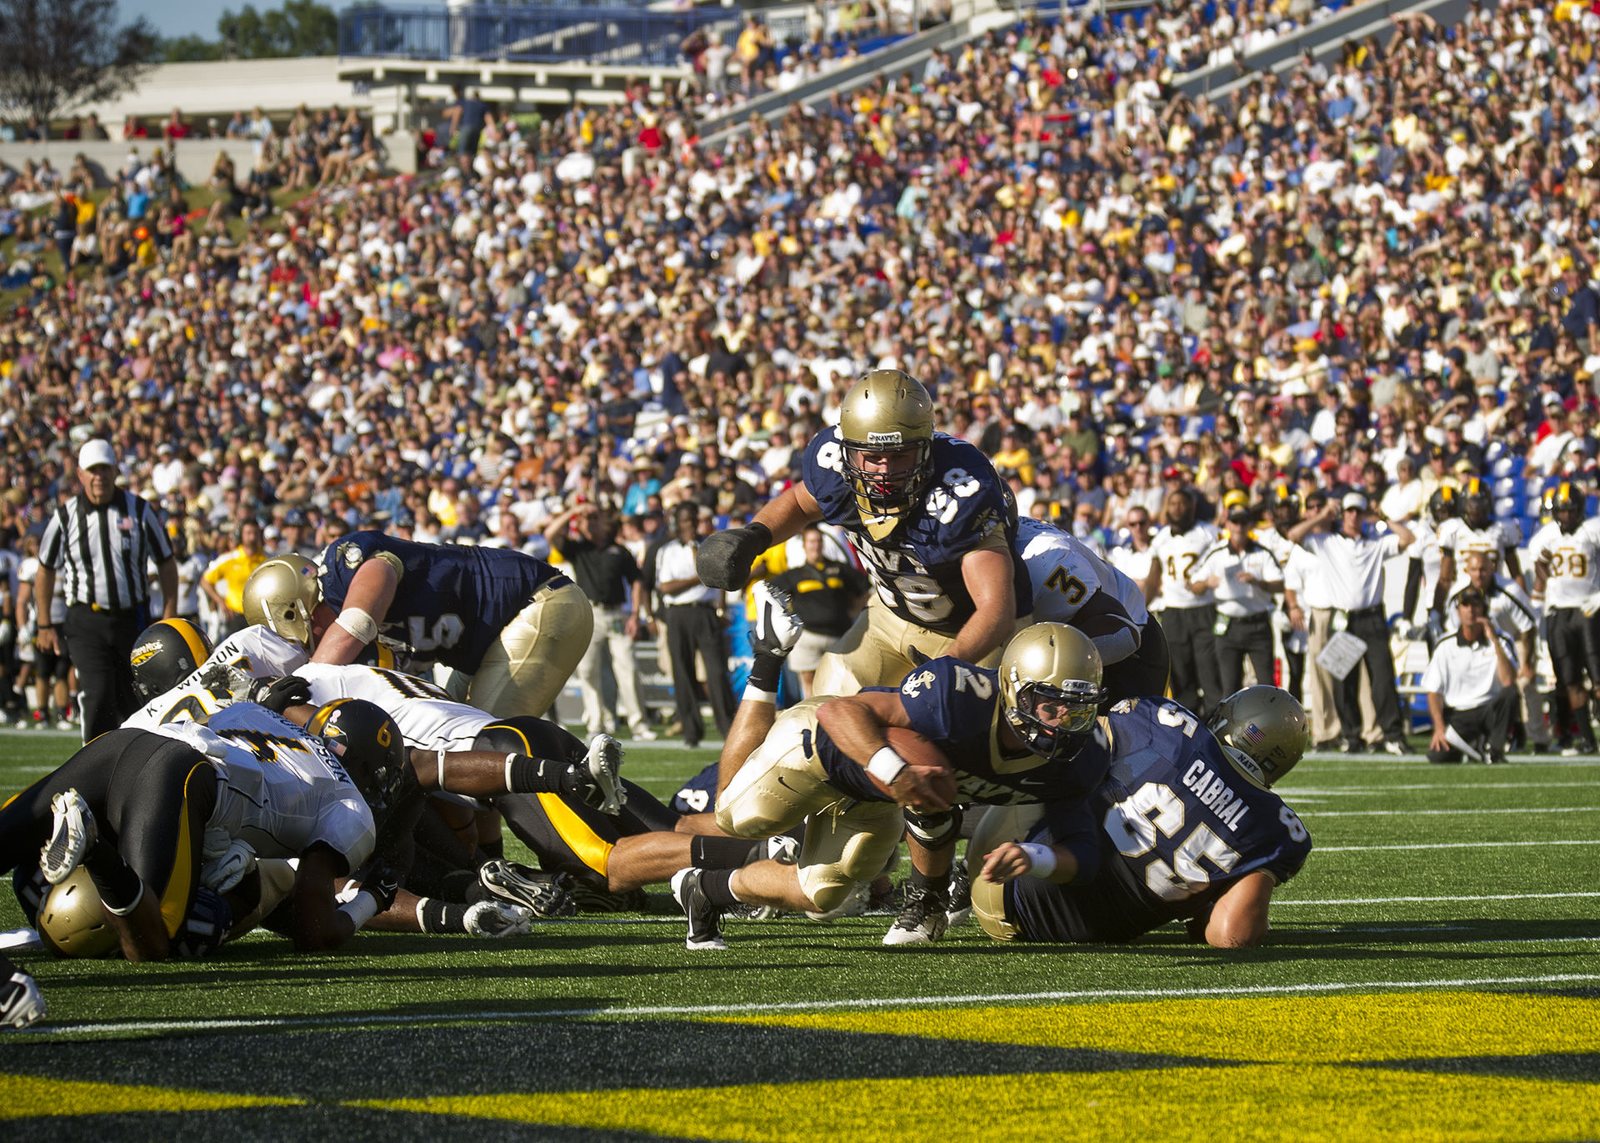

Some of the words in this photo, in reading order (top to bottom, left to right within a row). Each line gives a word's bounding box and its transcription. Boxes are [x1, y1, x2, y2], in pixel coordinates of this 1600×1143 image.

[874, 434, 894, 442] NAVY
[1167, 552, 1199, 581] 42
[1551, 553, 1587, 578] 28
[1043, 564, 1088, 606] 3
[954, 665, 993, 700] 2
[146, 703, 163, 718] K.
[376, 720, 392, 748] 6
[1238, 753, 1258, 773] NAVY
[1182, 759, 1250, 832] CABRAL
[1104, 781, 1242, 900] 65
